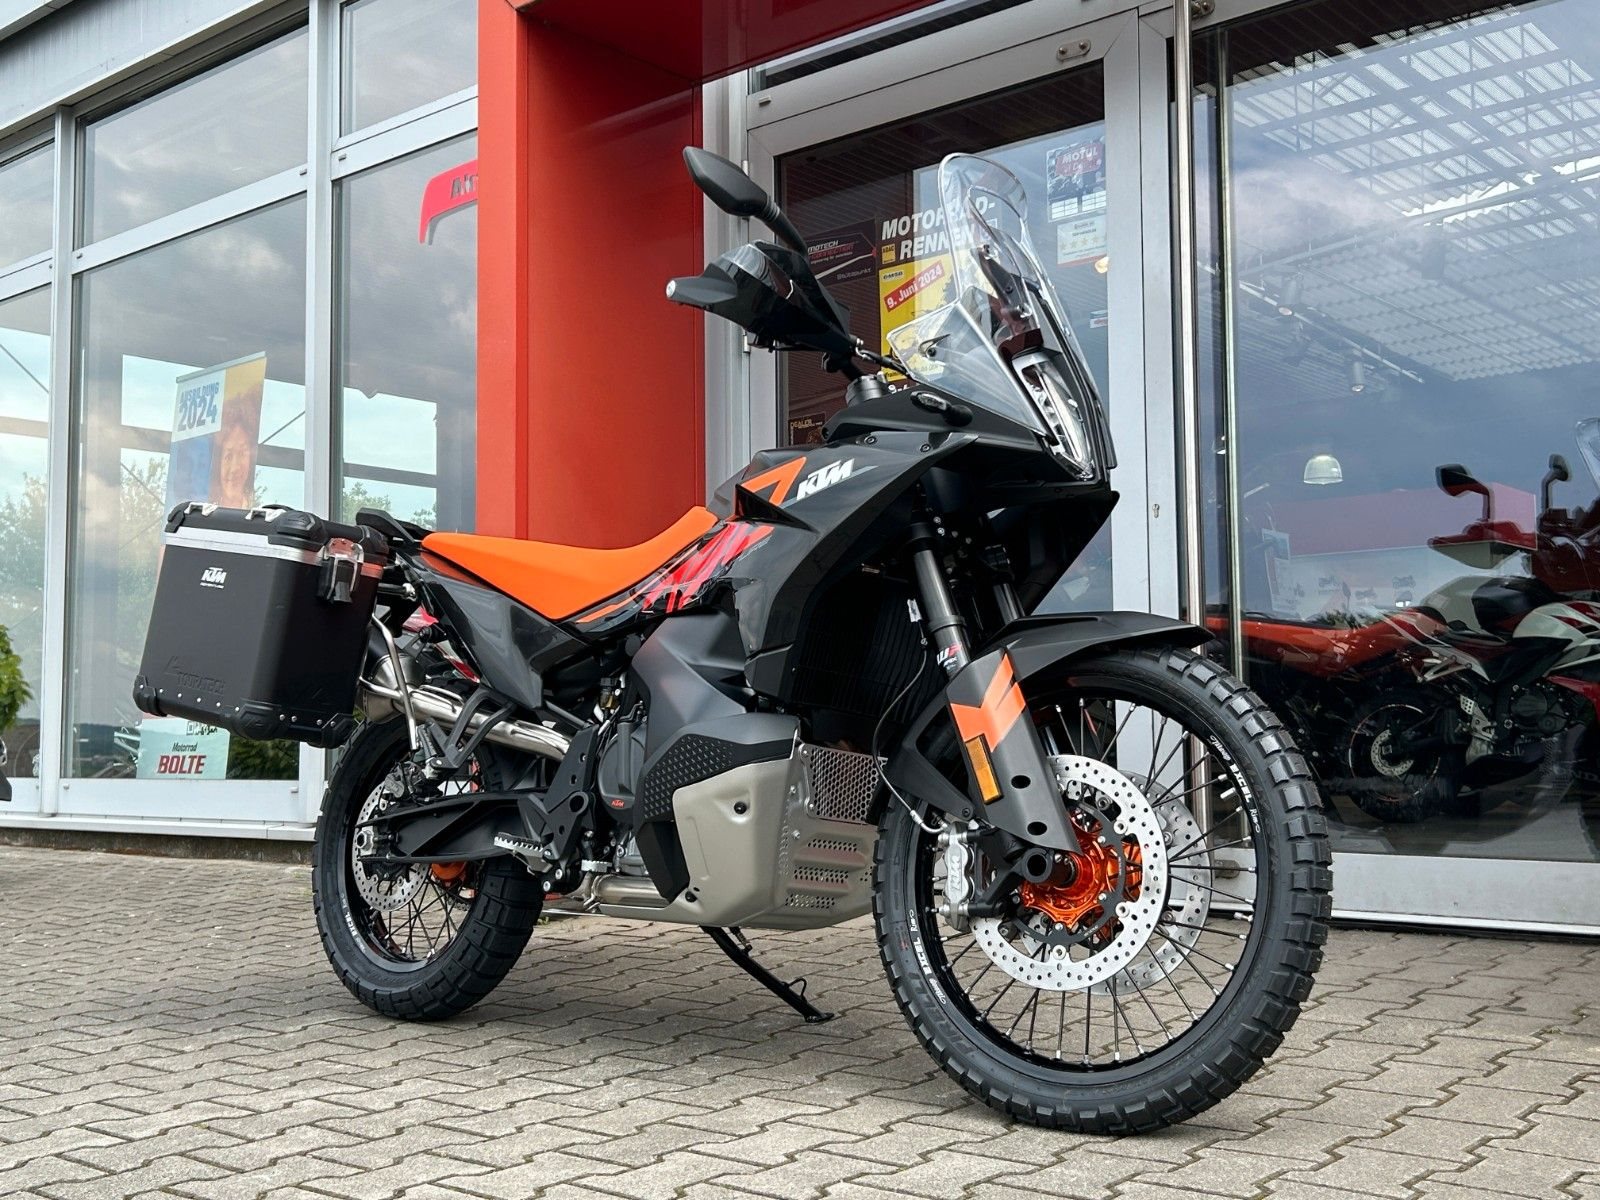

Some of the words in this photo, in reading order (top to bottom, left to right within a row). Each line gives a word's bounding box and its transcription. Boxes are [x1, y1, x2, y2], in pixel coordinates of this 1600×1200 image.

[1062, 146, 1098, 163] MOTUL
[899, 281, 918, 302] Juni
[918, 264, 943, 288] 2024
[178, 394, 218, 432] 2024
[796, 458, 855, 500] KTM
[201, 567, 227, 584] KTM
[172, 742, 198, 752] Motorrad
[158, 755, 207, 774] BOLTE
[1229, 763, 1252, 803] EXCEL
[611, 800, 624, 808] KTM
[913, 936, 932, 975] EXCEL
